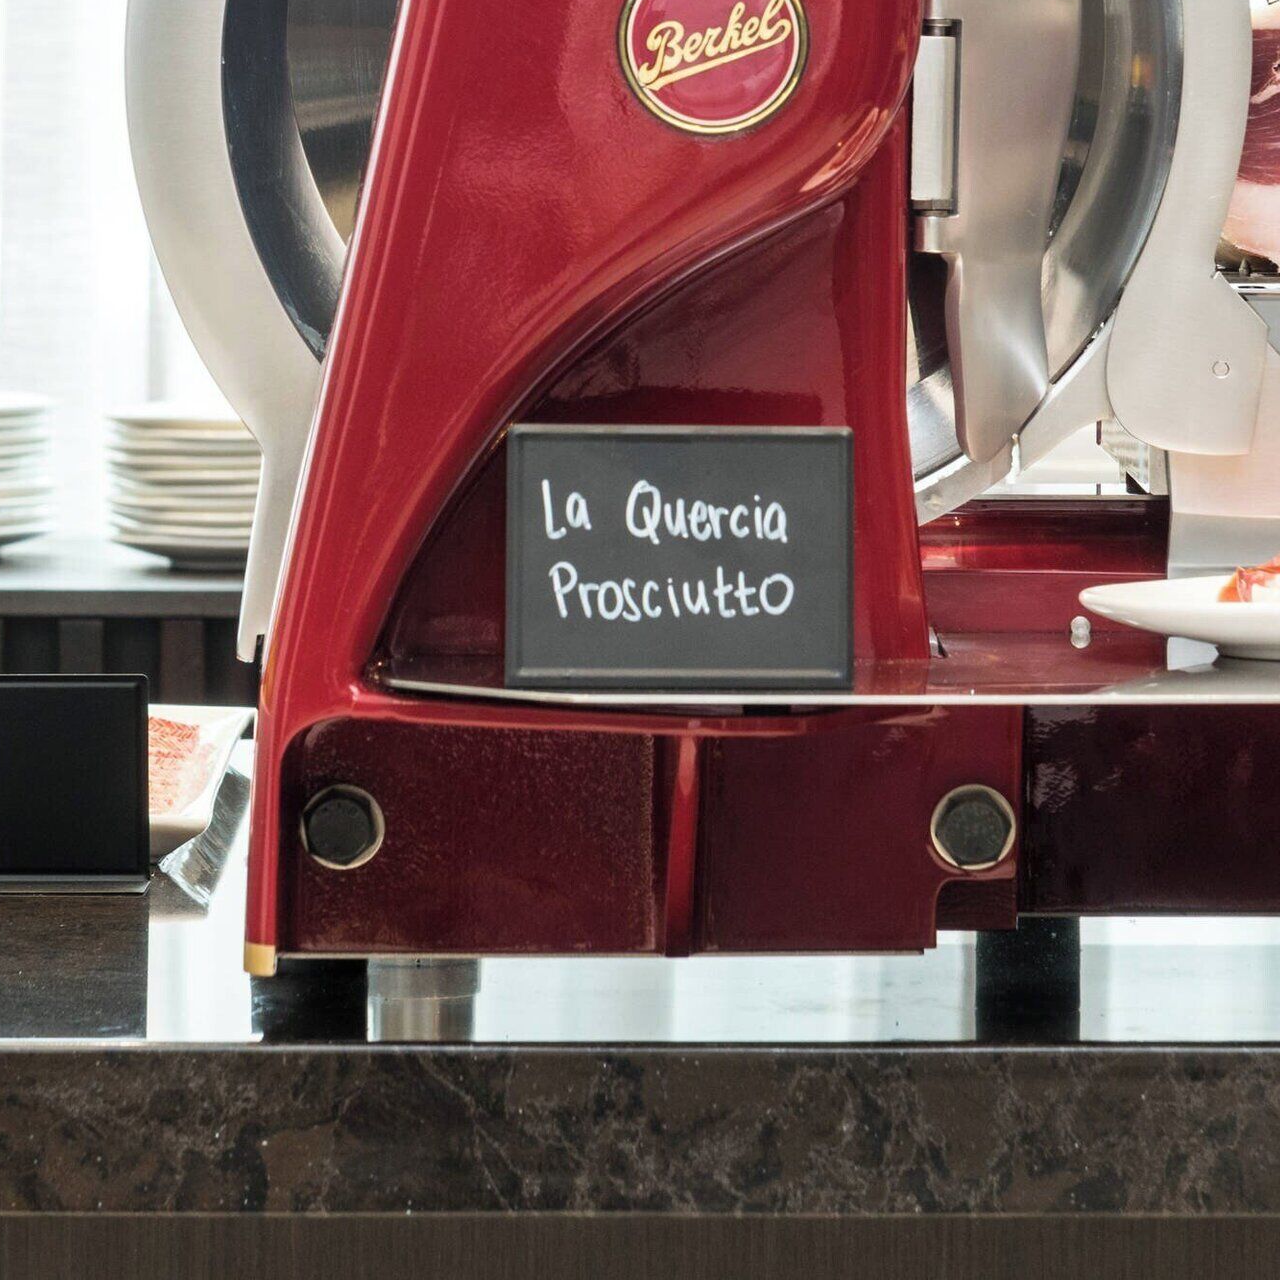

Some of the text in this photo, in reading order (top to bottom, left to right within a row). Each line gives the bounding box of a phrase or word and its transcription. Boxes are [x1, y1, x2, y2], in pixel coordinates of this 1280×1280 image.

[542, 479, 788, 545] La Quercia
[548, 561, 795, 622] Prosciutto
